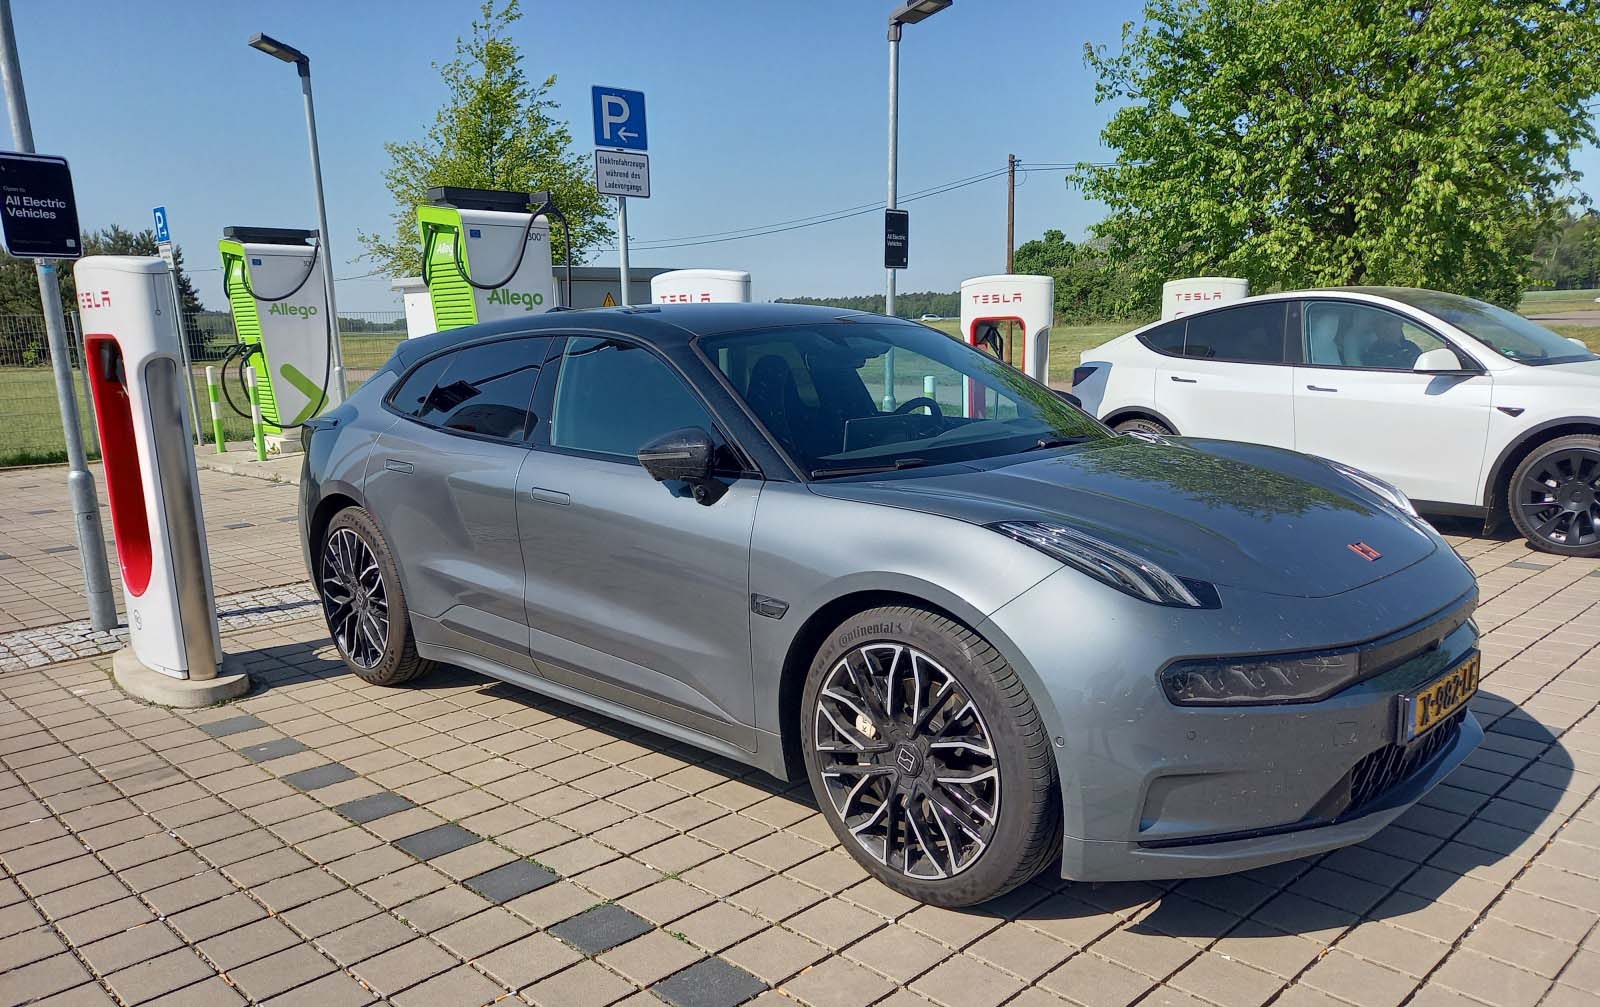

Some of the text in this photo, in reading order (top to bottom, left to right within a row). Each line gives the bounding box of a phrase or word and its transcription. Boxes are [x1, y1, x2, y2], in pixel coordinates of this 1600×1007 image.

[601, 95, 630, 139] P
[599, 156, 646, 169] Elektrofahrzeuge
[605, 170, 641, 179] während des
[604, 180, 642, 192] Ladevorgangs
[6, 195, 66, 208] All Electric
[6, 206, 56, 219] Vehicles
[486, 288, 544, 311] Allego
[972, 293, 1022, 304] TESLA
[1175, 292, 1222, 302] TESLA
[268, 302, 318, 320] Allego
[840, 622, 893, 647] Continental
